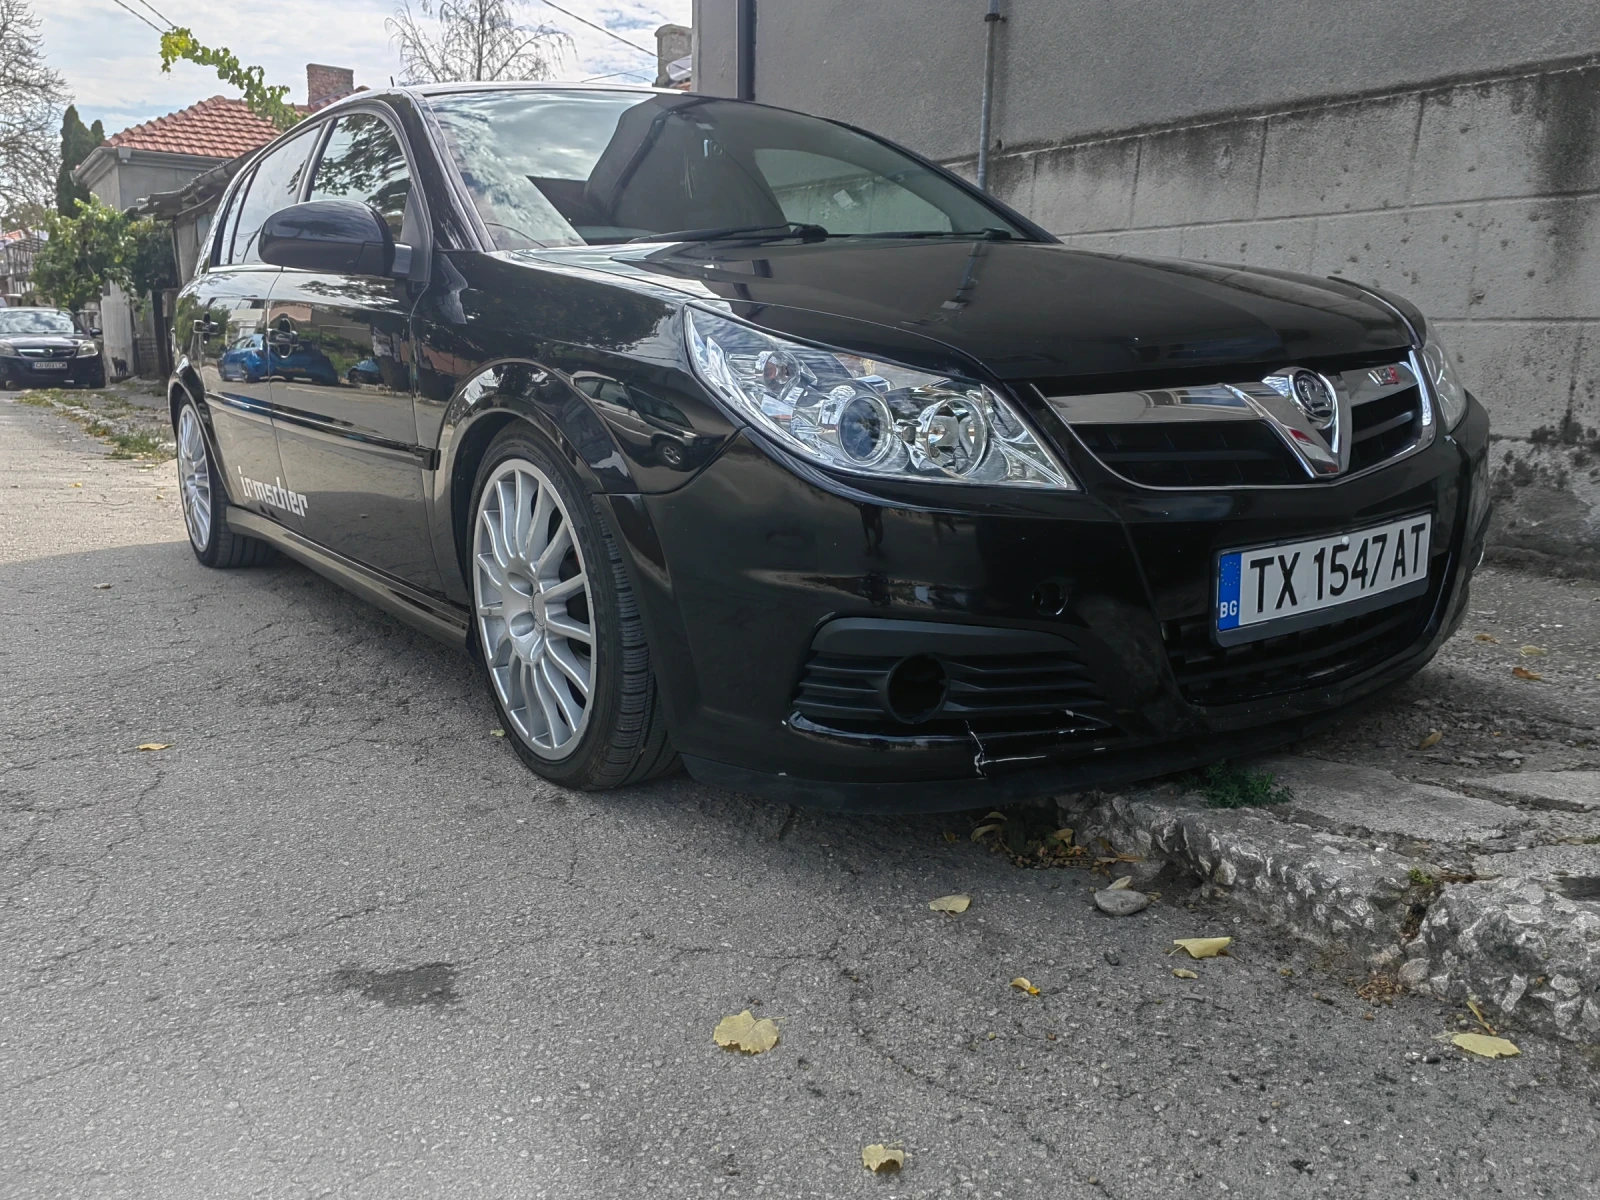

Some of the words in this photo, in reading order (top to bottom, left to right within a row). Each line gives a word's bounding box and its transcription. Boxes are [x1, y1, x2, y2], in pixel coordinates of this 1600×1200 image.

[237, 465, 309, 518] irmscher
[1249, 551, 1301, 614] TX
[1313, 532, 1388, 601] 1547
[1391, 522, 1427, 581] AT
[1219, 600, 1238, 619] BG
